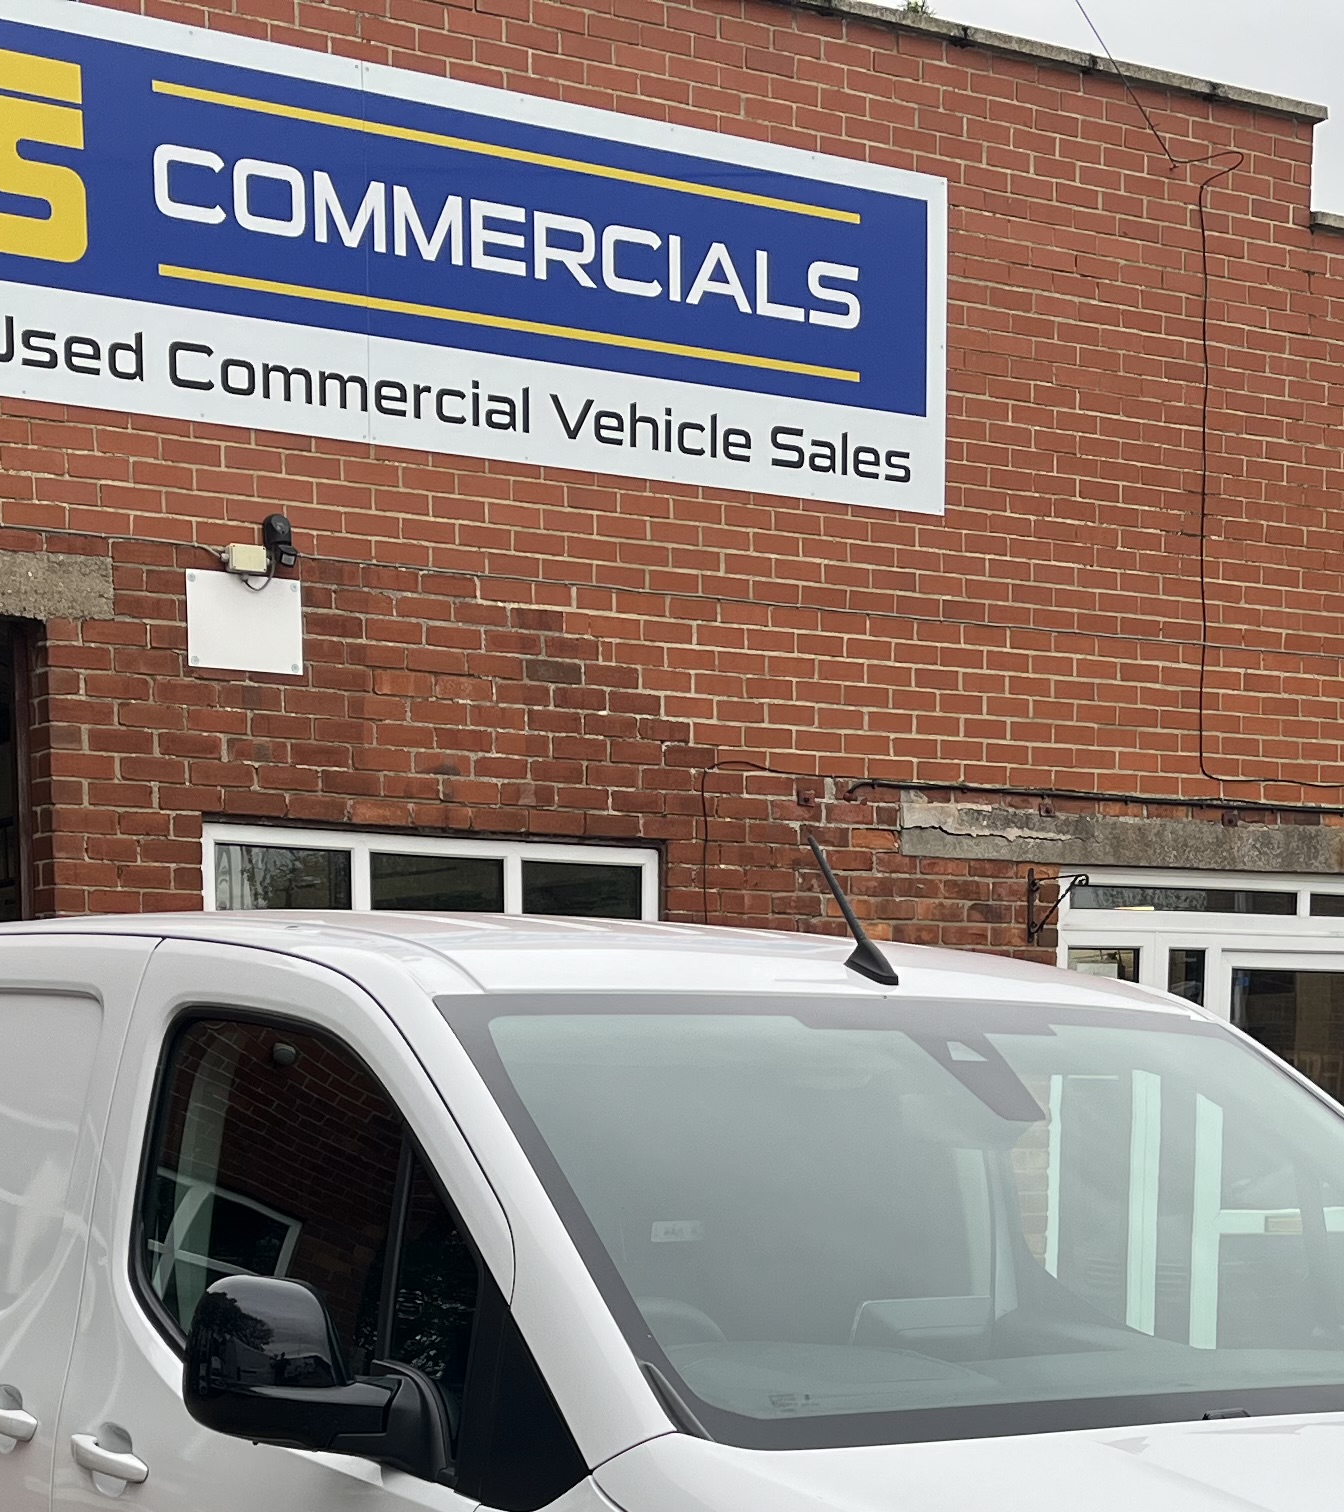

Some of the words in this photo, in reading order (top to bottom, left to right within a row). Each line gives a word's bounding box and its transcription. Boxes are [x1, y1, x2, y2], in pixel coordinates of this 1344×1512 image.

[153, 143, 860, 330] COMMERCIALS
[168, 340, 531, 434] Commercial
[550, 393, 753, 463] Vehicle
[770, 427, 913, 484] Sales
